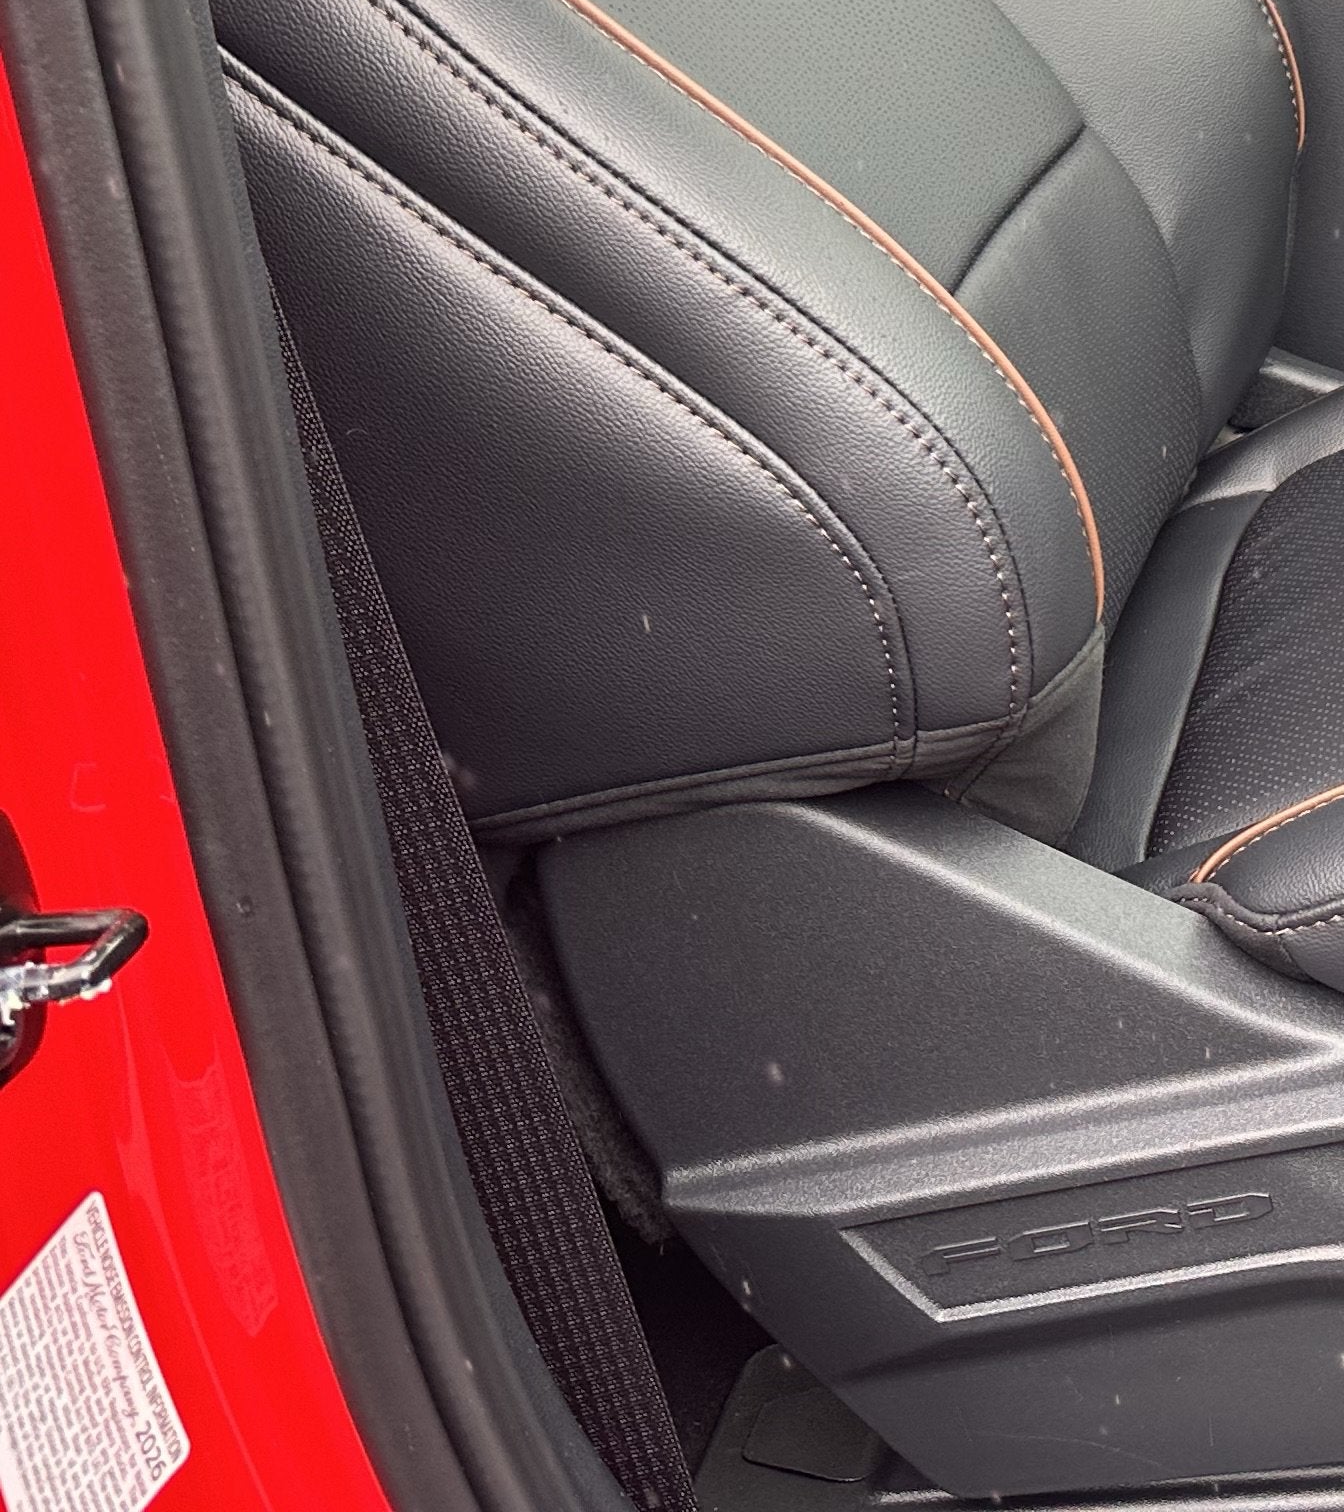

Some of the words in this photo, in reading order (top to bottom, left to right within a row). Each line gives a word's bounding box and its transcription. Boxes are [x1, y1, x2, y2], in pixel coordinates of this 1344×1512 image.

[73, 1231, 96, 1278] Ford
[919, 1192, 1274, 1276] FORD
[81, 1279, 119, 1331] Motor
[86, 1200, 109, 1253] VEHICLE
[100, 1248, 119, 1286] NOISE
[128, 1333, 154, 1391] CONTROL
[146, 1384, 182, 1464] INFORMATION
[135, 1420, 167, 1481] 2026
